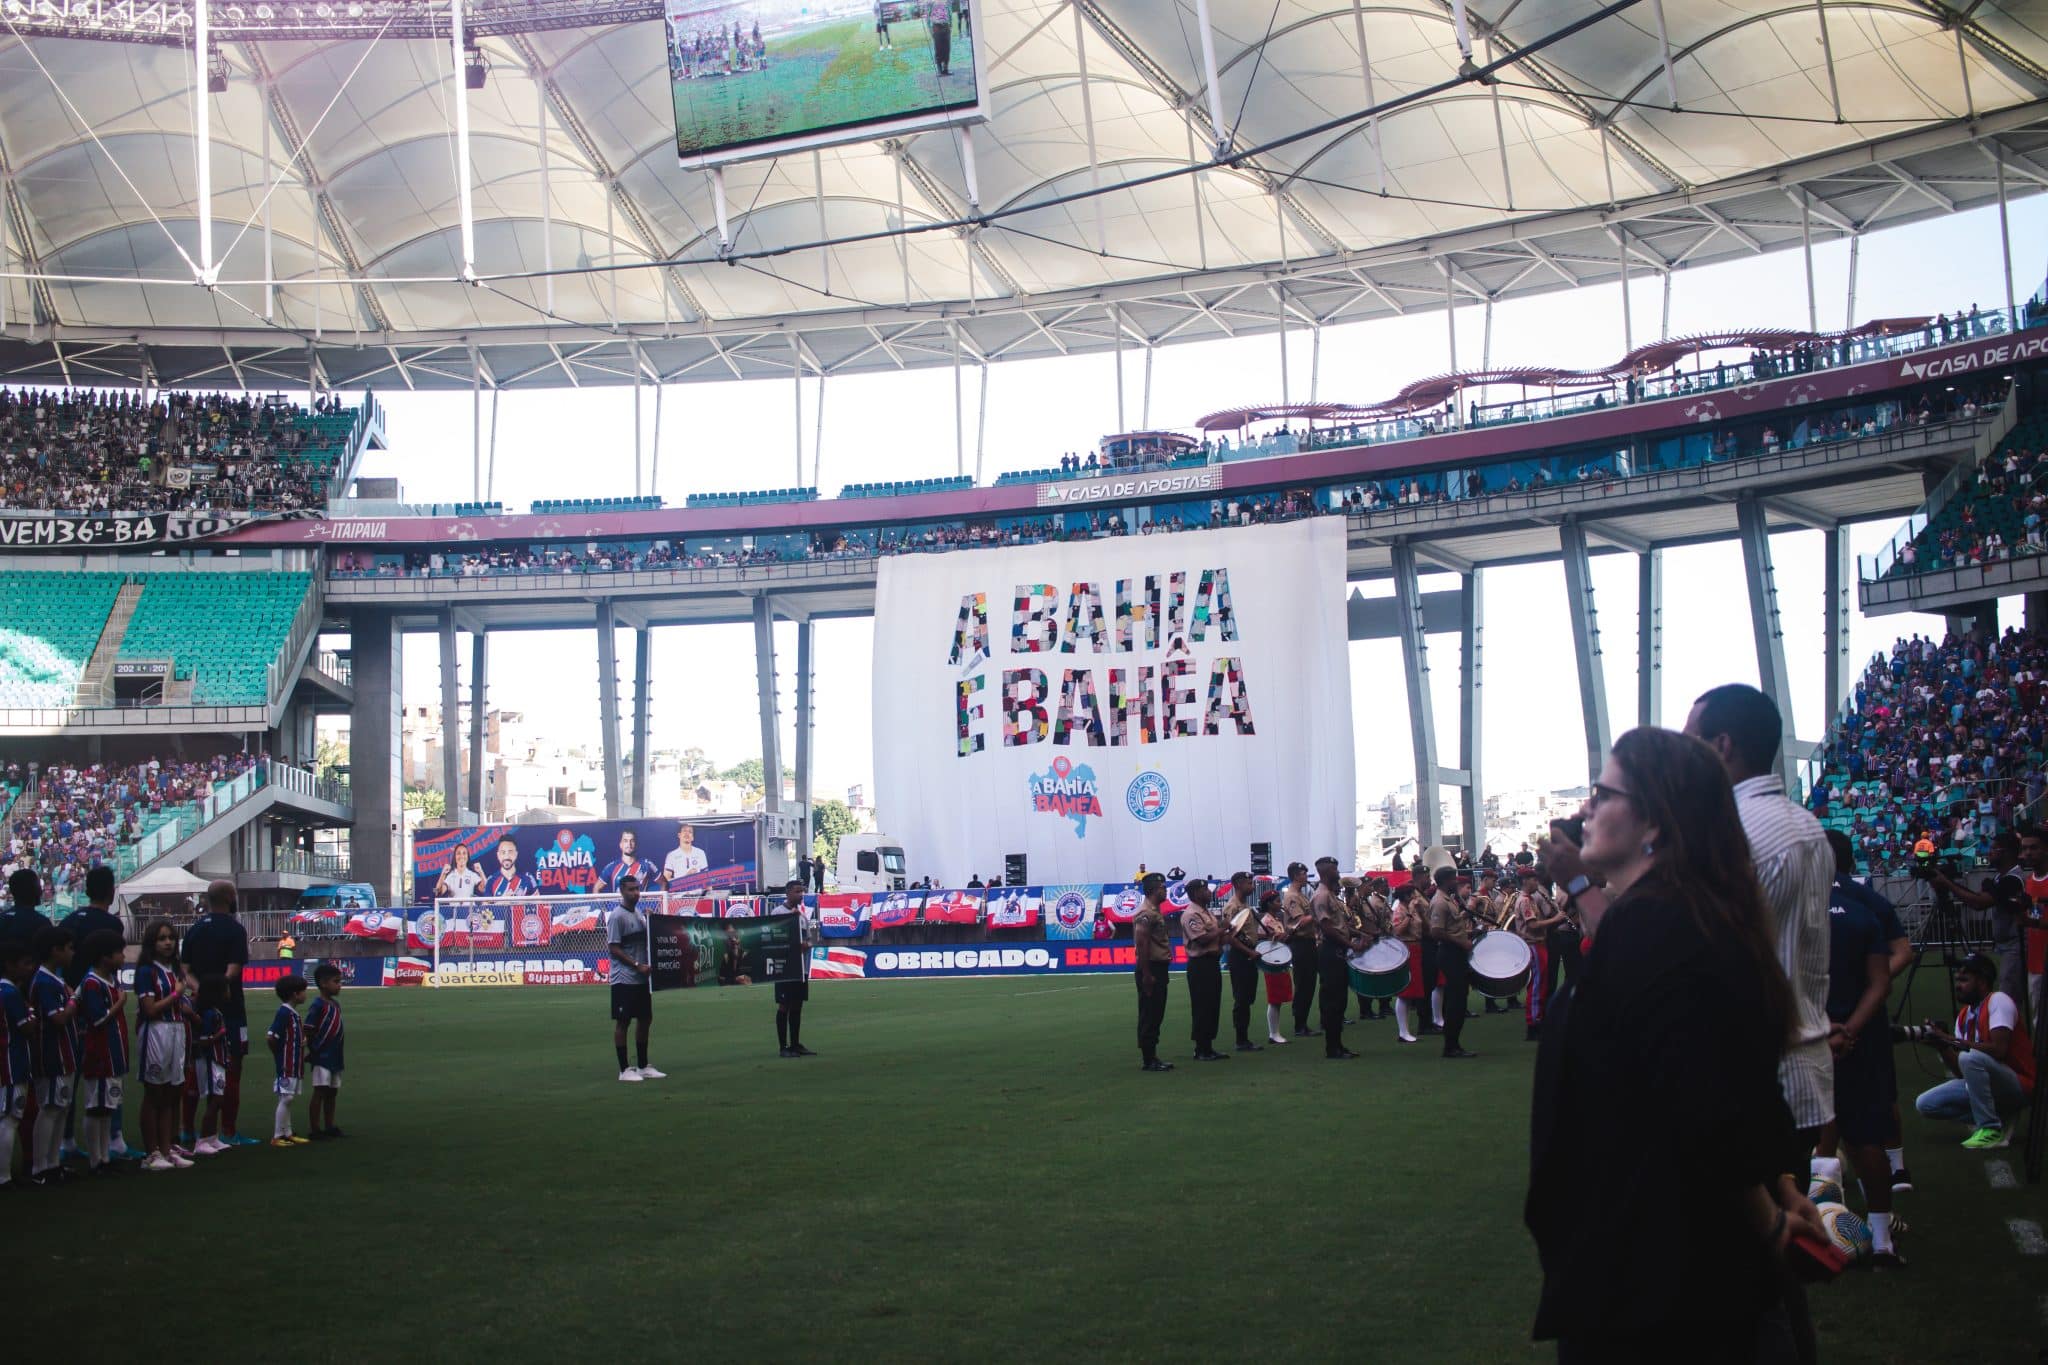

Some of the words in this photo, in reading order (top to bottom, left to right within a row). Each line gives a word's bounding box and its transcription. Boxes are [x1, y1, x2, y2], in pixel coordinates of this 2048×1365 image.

[1927, 353, 1978, 377] CASA
[1983, 346, 2009, 366] DE
[1069, 487, 1111, 500] CASA
[1114, 484, 1135, 496] DE
[1137, 475, 1212, 494] APOSTAS
[331, 522, 386, 539] ITAIPAVA
[948, 593, 991, 665] A
[1010, 568, 1240, 655] BAHIA
[117, 665, 135, 673] 202
[152, 664, 168, 673] 201
[957, 649, 986, 758] É
[1002, 636, 1256, 747] BAHÊA
[538, 856, 547, 869] A
[547, 847, 593, 868] BAHIA
[823, 916, 850, 925] BBMB
[528, 973, 584, 983] SUPERBET
